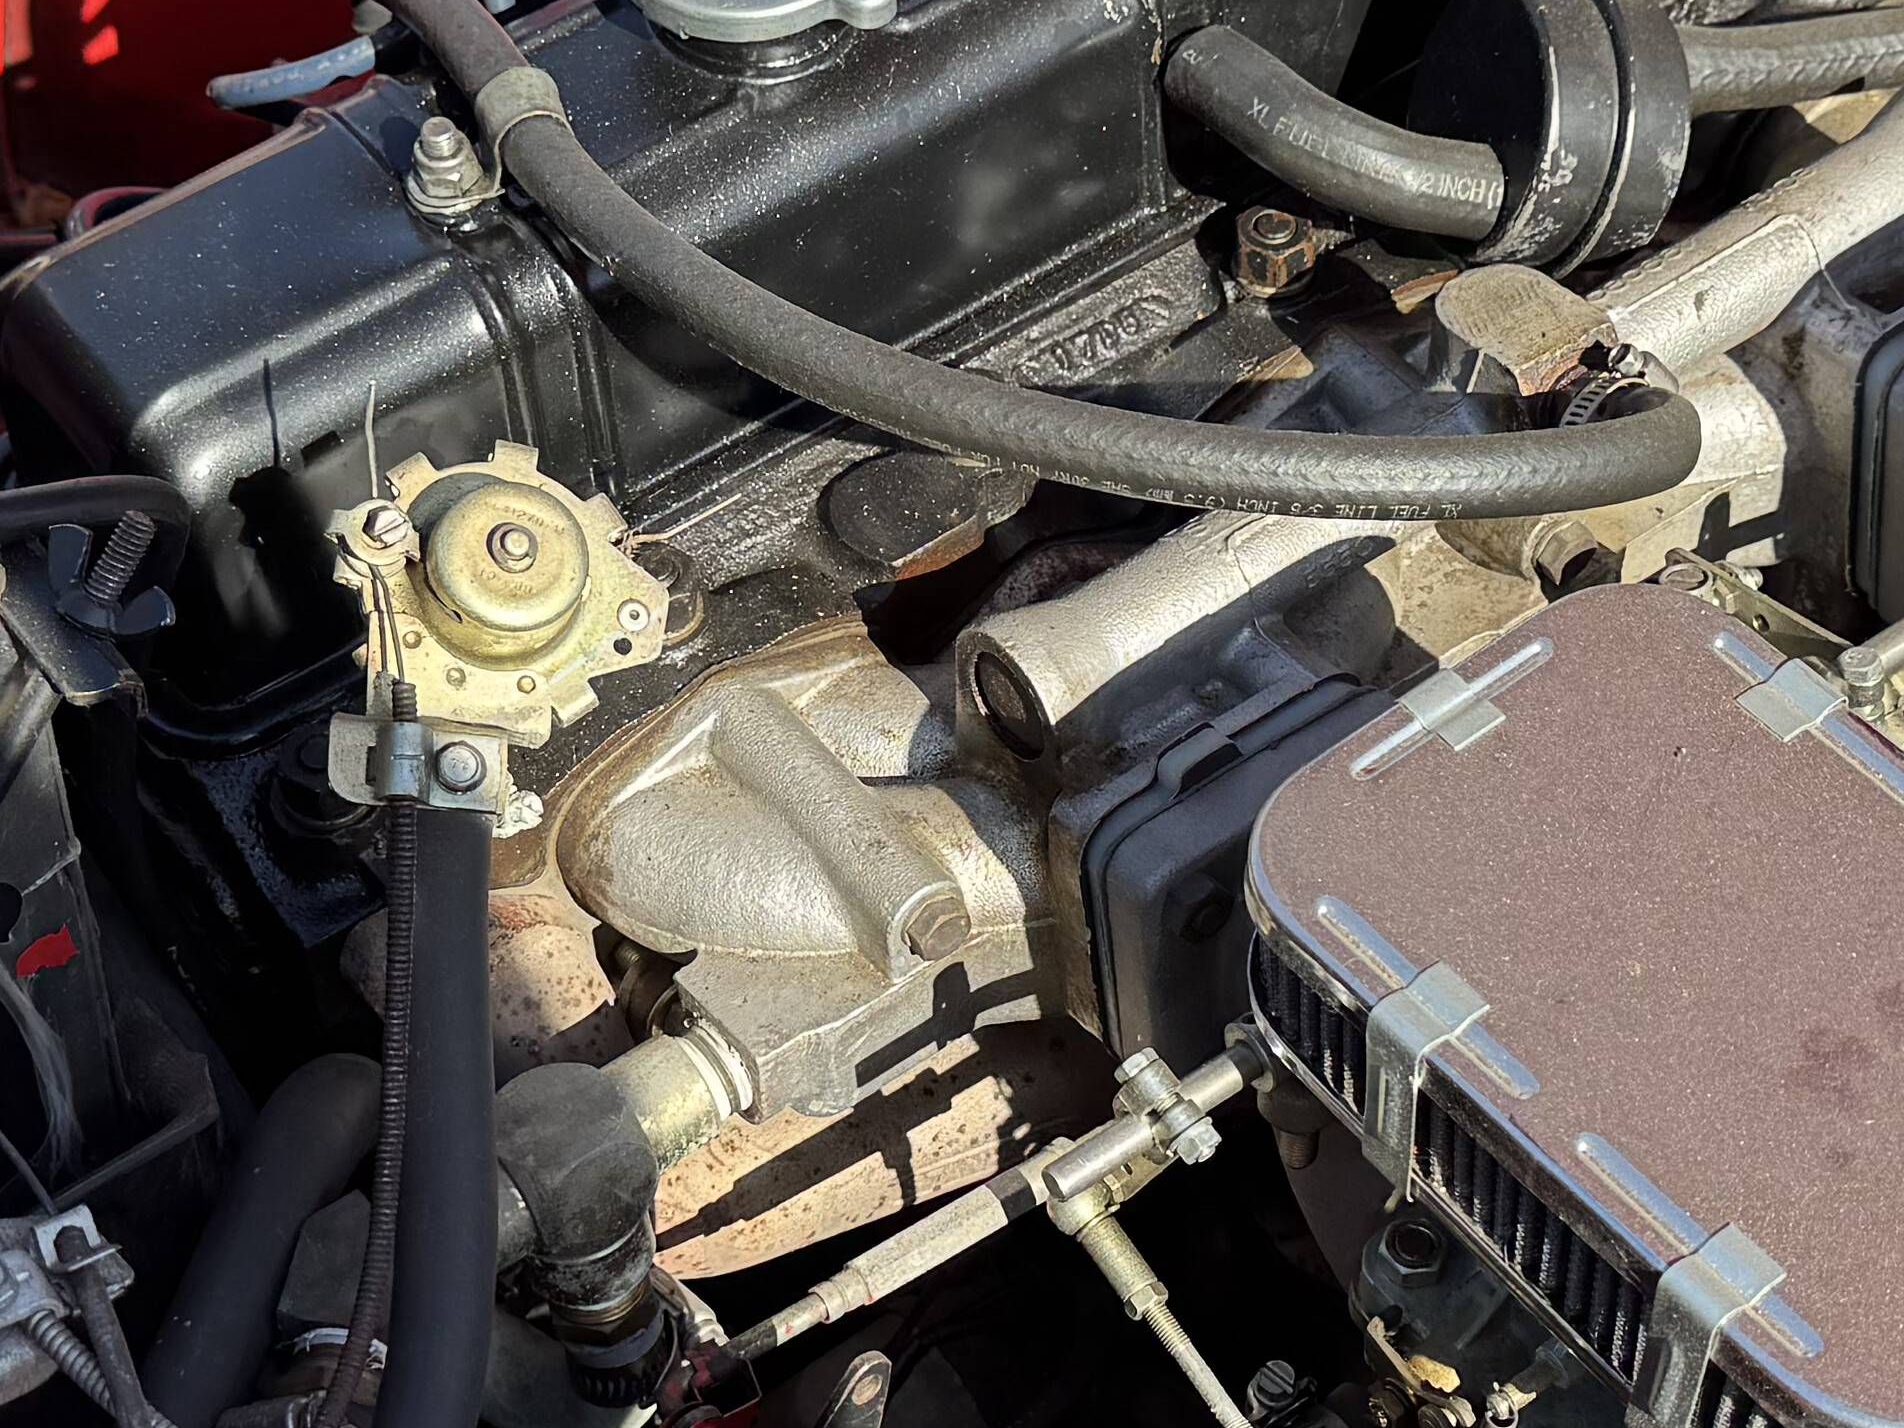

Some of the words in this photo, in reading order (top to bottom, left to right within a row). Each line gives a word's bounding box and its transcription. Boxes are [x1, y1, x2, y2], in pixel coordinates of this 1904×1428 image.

[1245, 96, 1272, 129] XL
[1271, 116, 1330, 160] FUEL
[1436, 171, 1487, 204] INCH
[1236, 497, 1278, 513] INCH
[1333, 504, 1376, 518] LINE
[1388, 505, 1429, 519] FUEL
